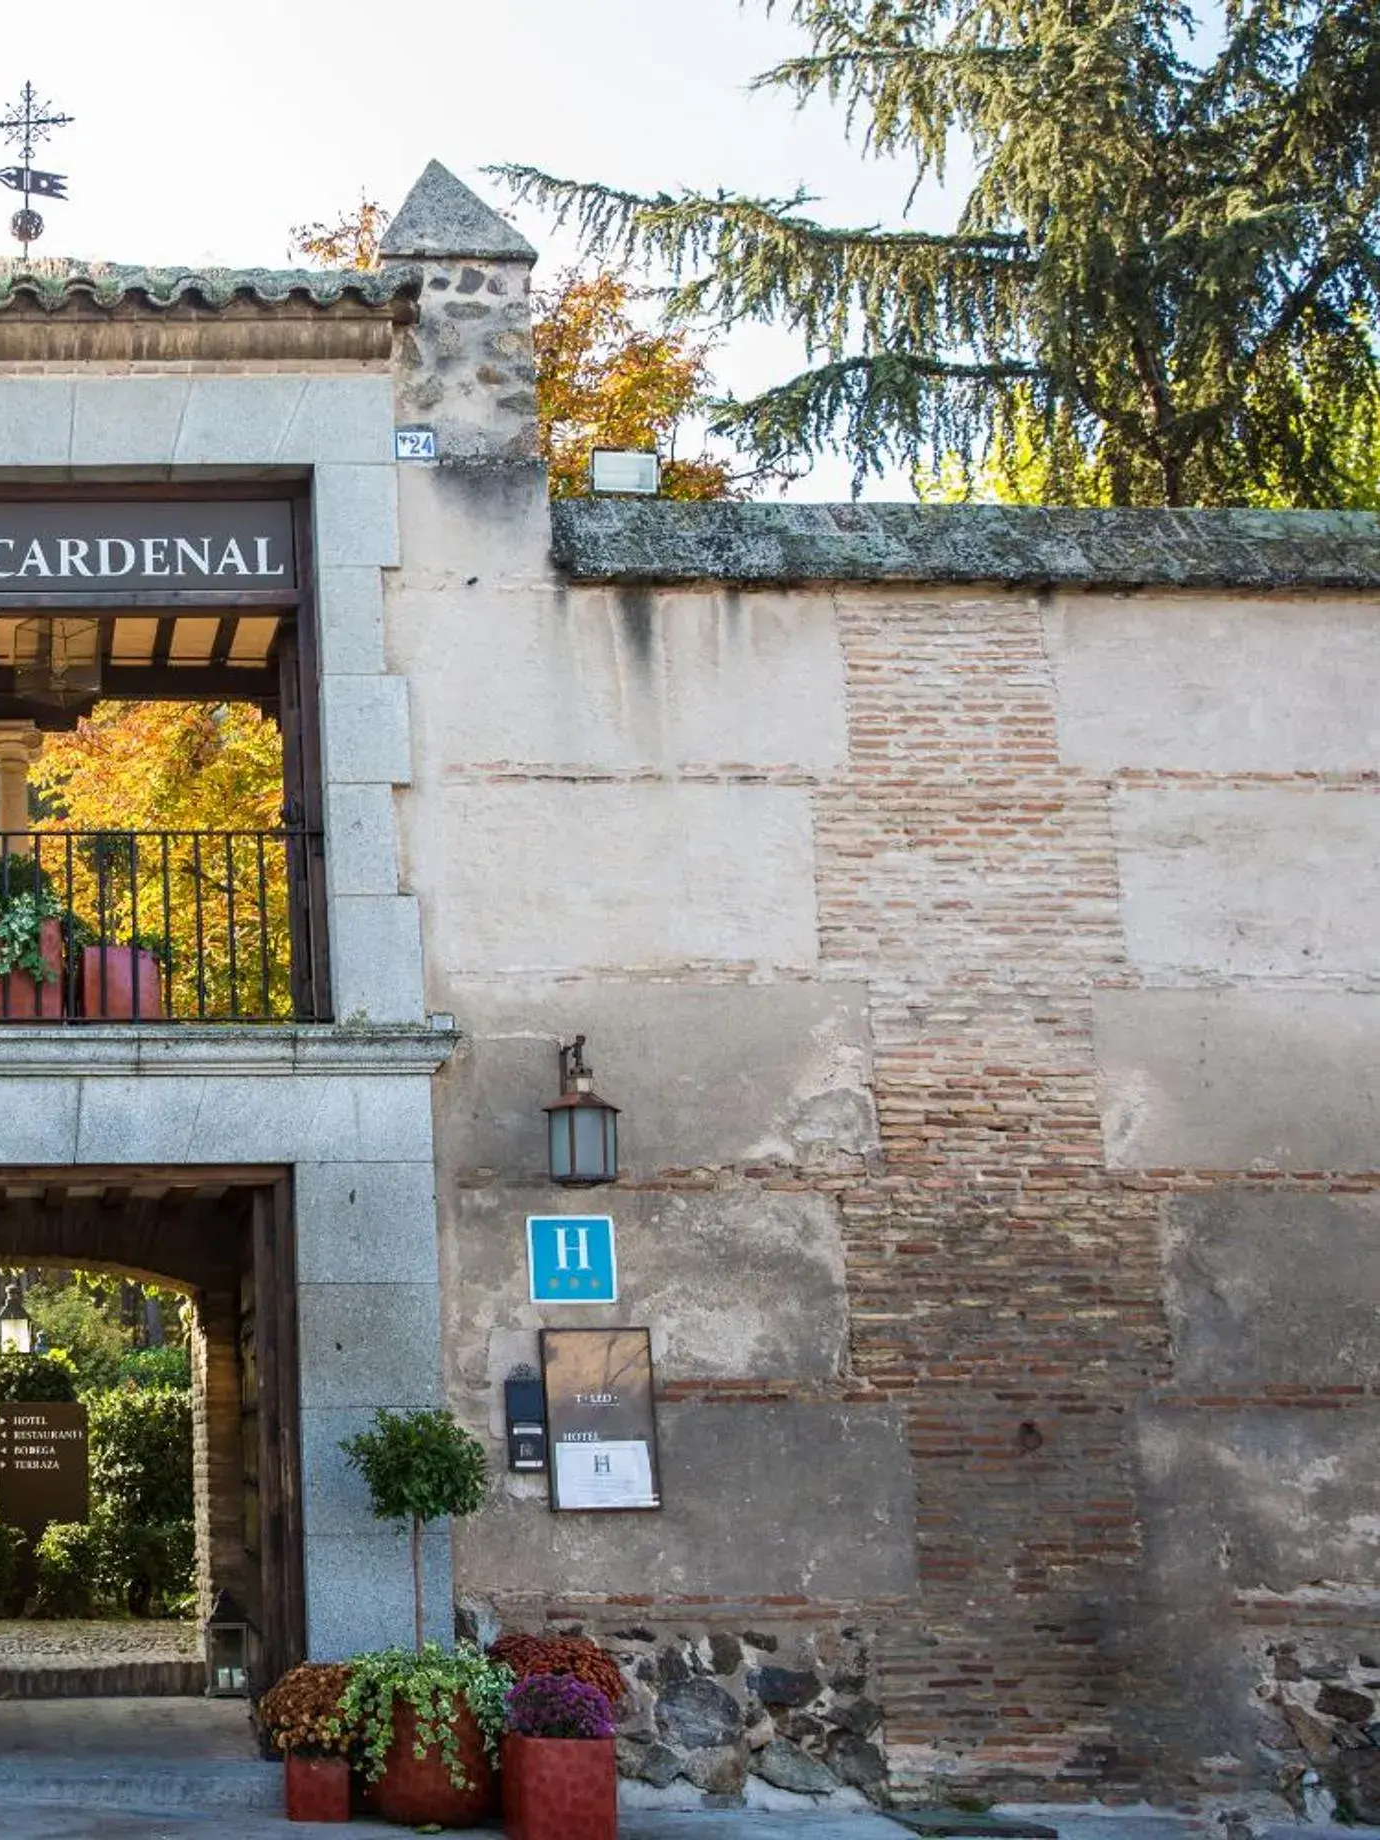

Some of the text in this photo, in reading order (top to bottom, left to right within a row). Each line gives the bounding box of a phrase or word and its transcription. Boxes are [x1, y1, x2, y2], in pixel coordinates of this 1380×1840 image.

[553, 1226, 592, 1270] H
[13, 1416, 48, 1425] HOTEL
[13, 1430, 84, 1440] RESTAURANTE
[14, 1446, 56, 1455] BODEGA
[15, 1460, 60, 1470] TERRAZA
